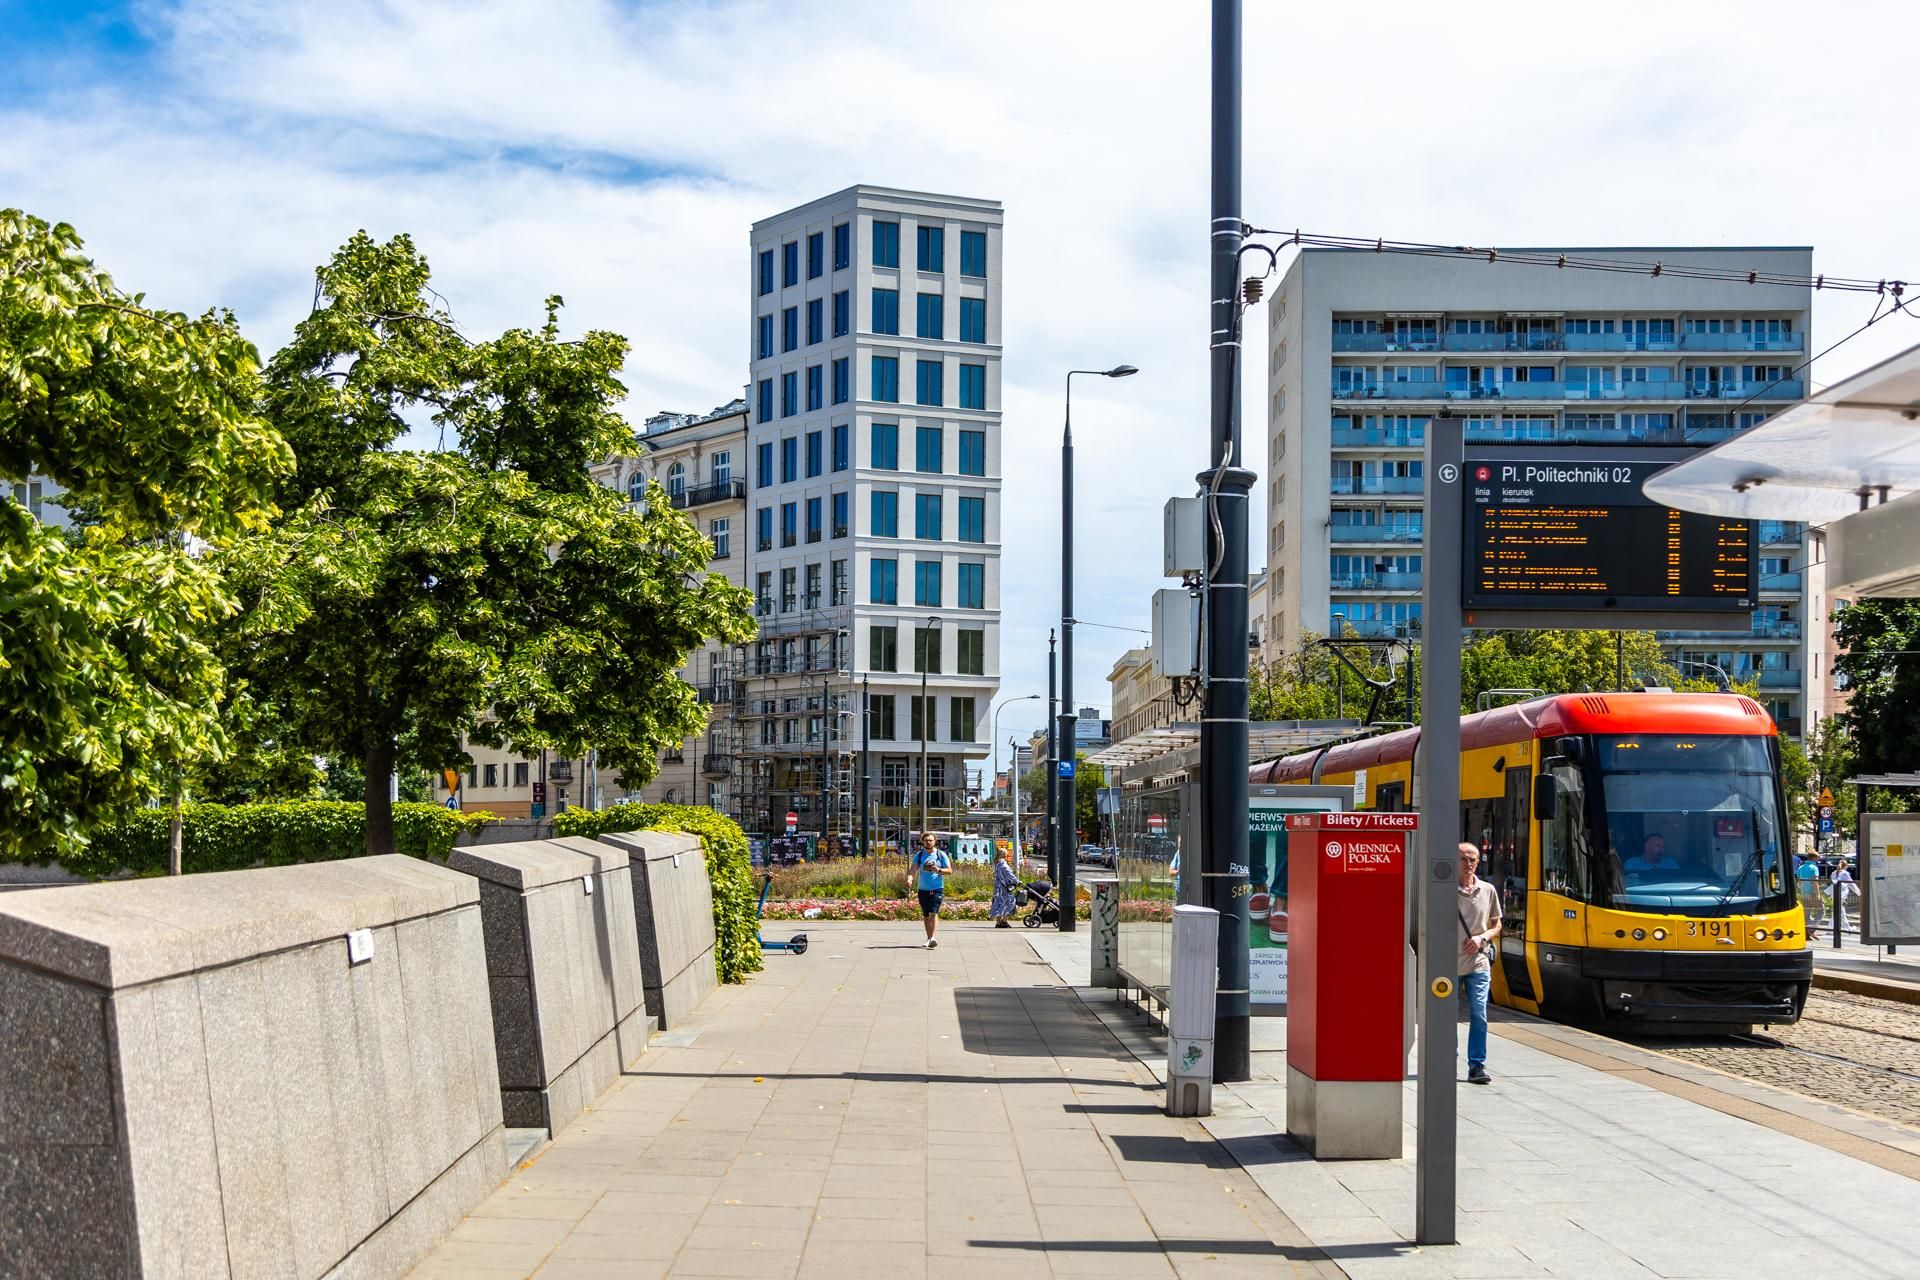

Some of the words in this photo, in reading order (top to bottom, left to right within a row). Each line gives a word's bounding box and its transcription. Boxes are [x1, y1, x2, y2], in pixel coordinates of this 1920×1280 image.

[1502, 467, 1521, 482] Pl.
[1526, 467, 1608, 482] Politechniki
[1612, 468, 1631, 483] 02
[1475, 488, 1491, 496] linia
[1502, 488, 1534, 496] kierunek
[1821, 808, 1830, 816] 30
[1327, 815, 1362, 828] Bilety
[1364, 815, 1371, 826] /
[1372, 815, 1414, 826] Tickets
[1822, 820, 1830, 830] P
[1348, 843, 1401, 853] MENNICA
[1348, 854, 1391, 863] POLSKA
[1685, 921, 1731, 937] 3191
